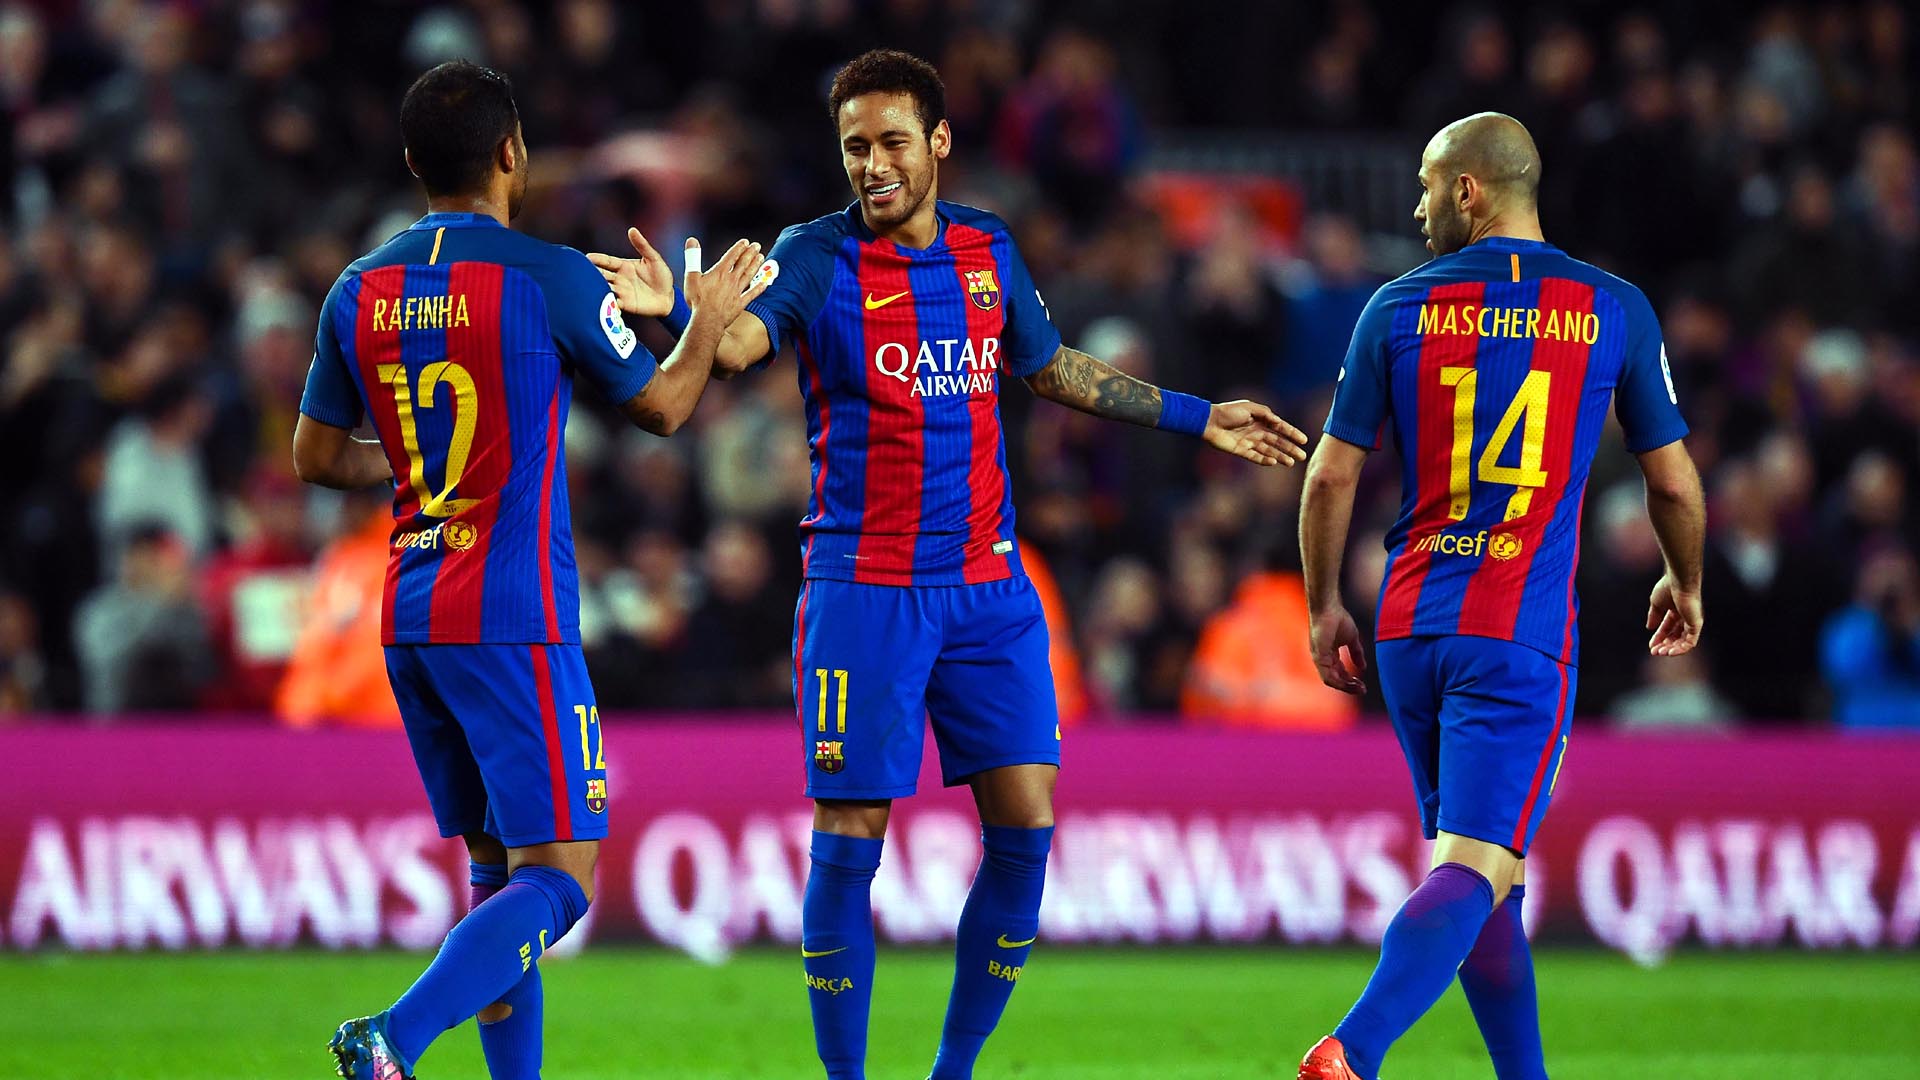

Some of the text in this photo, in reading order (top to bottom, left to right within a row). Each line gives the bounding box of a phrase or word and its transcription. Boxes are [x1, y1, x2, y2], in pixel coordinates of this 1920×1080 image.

[373, 294, 471, 331] RAFINHA
[875, 337, 999, 383] QATAR
[1416, 304, 1600, 344] MASCHERANO
[377, 361, 481, 517] 12
[1440, 366, 1551, 522] 14
[574, 704, 606, 771] 12
[816, 669, 849, 733] 11
[10, 814, 455, 950] AIRWAYS
[632, 814, 984, 965] QAAR
[1578, 816, 1882, 967] QATAR
